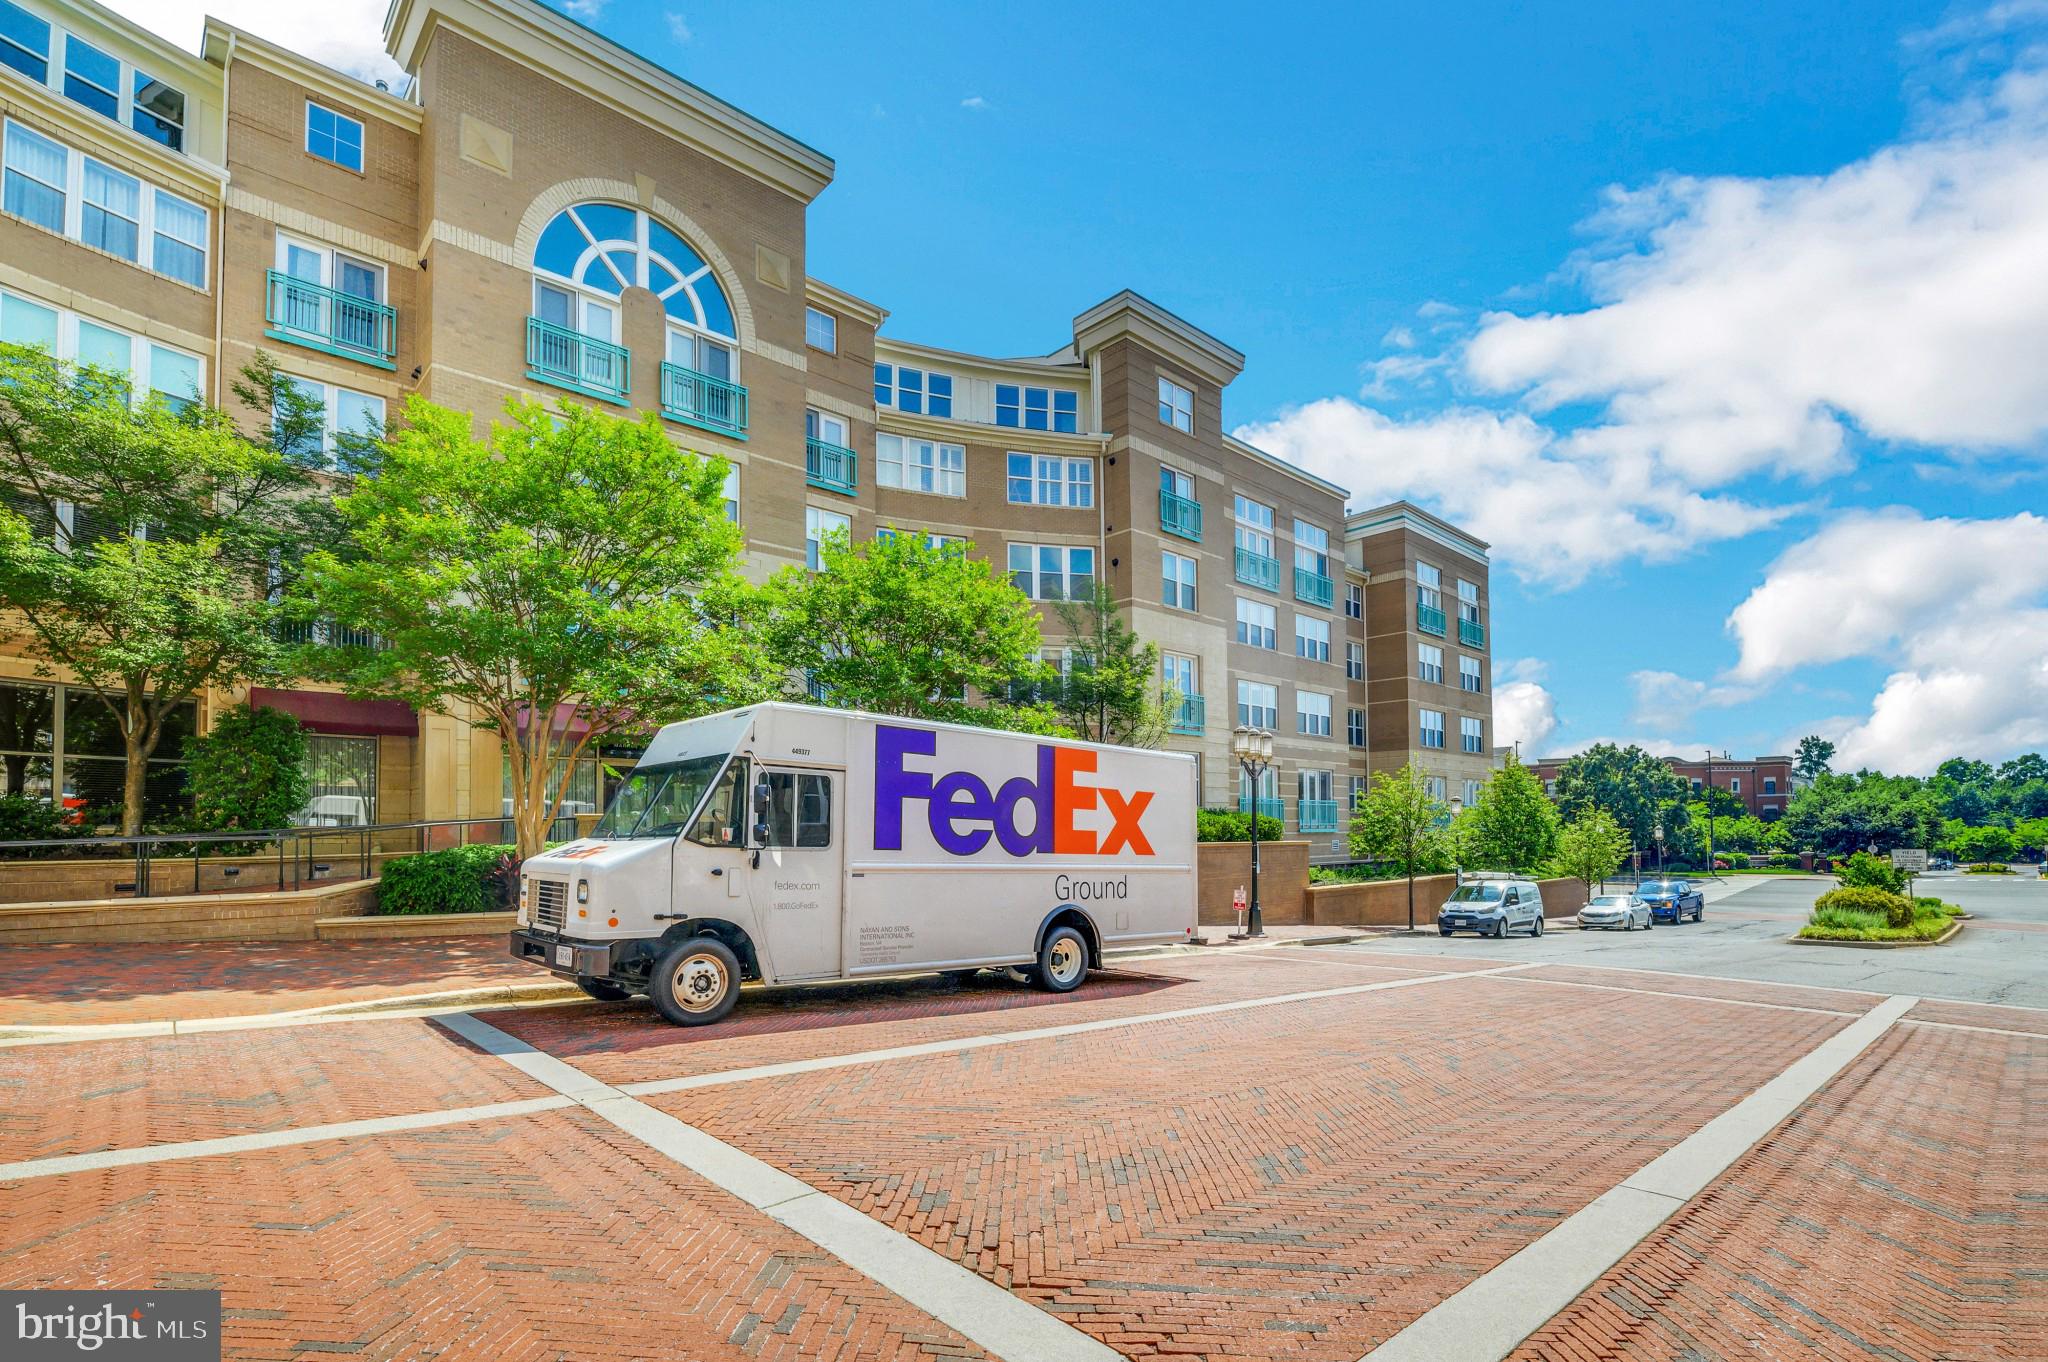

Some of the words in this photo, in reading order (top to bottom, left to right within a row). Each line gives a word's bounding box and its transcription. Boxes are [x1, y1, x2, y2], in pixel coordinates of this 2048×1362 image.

[873, 724, 1156, 857] FedEx
[774, 880, 821, 890] fedex.com
[1055, 874, 1127, 901] Ground
[860, 932, 904, 940] INTERNATIONAL
